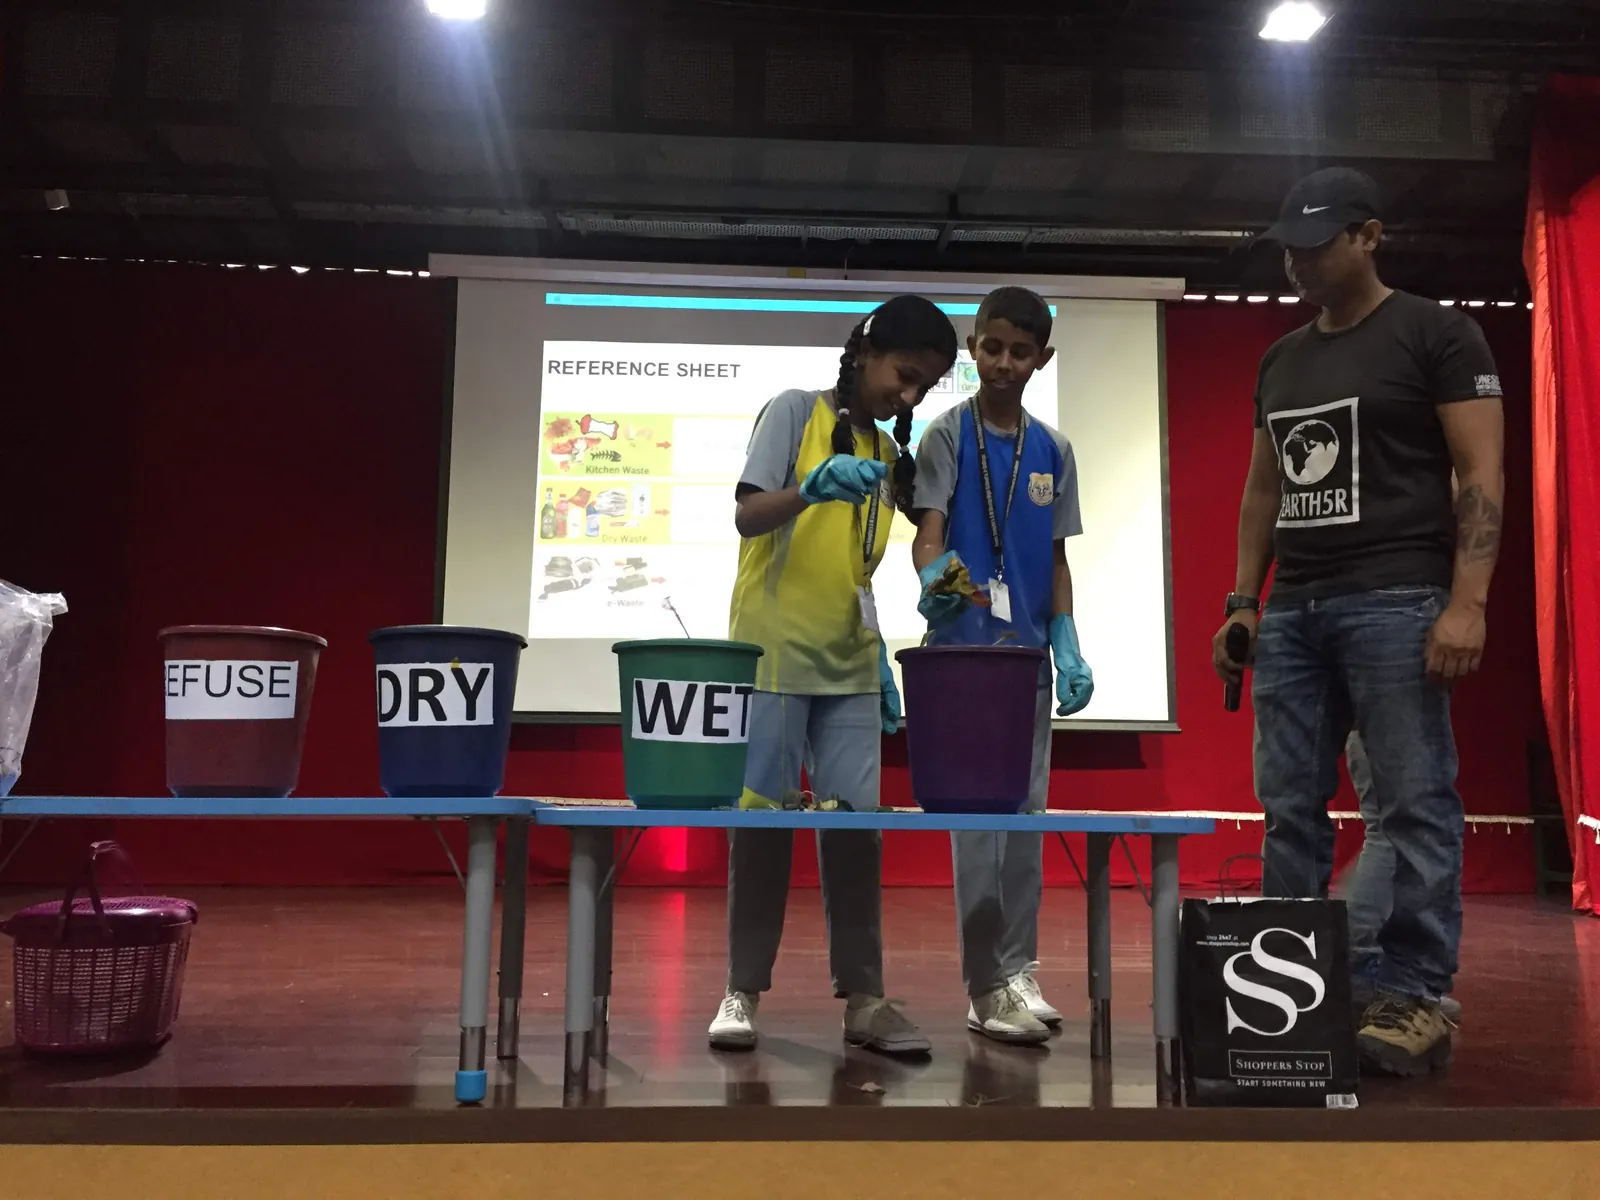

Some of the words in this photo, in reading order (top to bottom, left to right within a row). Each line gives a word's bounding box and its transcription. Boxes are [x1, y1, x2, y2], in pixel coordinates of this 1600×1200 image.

[548, 360, 670, 377] REFERENCE
[676, 362, 741, 378] SHEET
[585, 465, 620, 475] Kitchen
[622, 466, 650, 475] Waste
[602, 534, 618, 544] Dry
[620, 535, 648, 543] Waste
[167, 664, 292, 698] EFUSE
[378, 667, 490, 722] DRY
[635, 680, 754, 737] WET
[1236, 1058, 1292, 1070] SHOPPERS
[1296, 1060, 1325, 1071] STOP
[1237, 1079, 1259, 1087] START
[1262, 1080, 1306, 1088] SOMETHING
